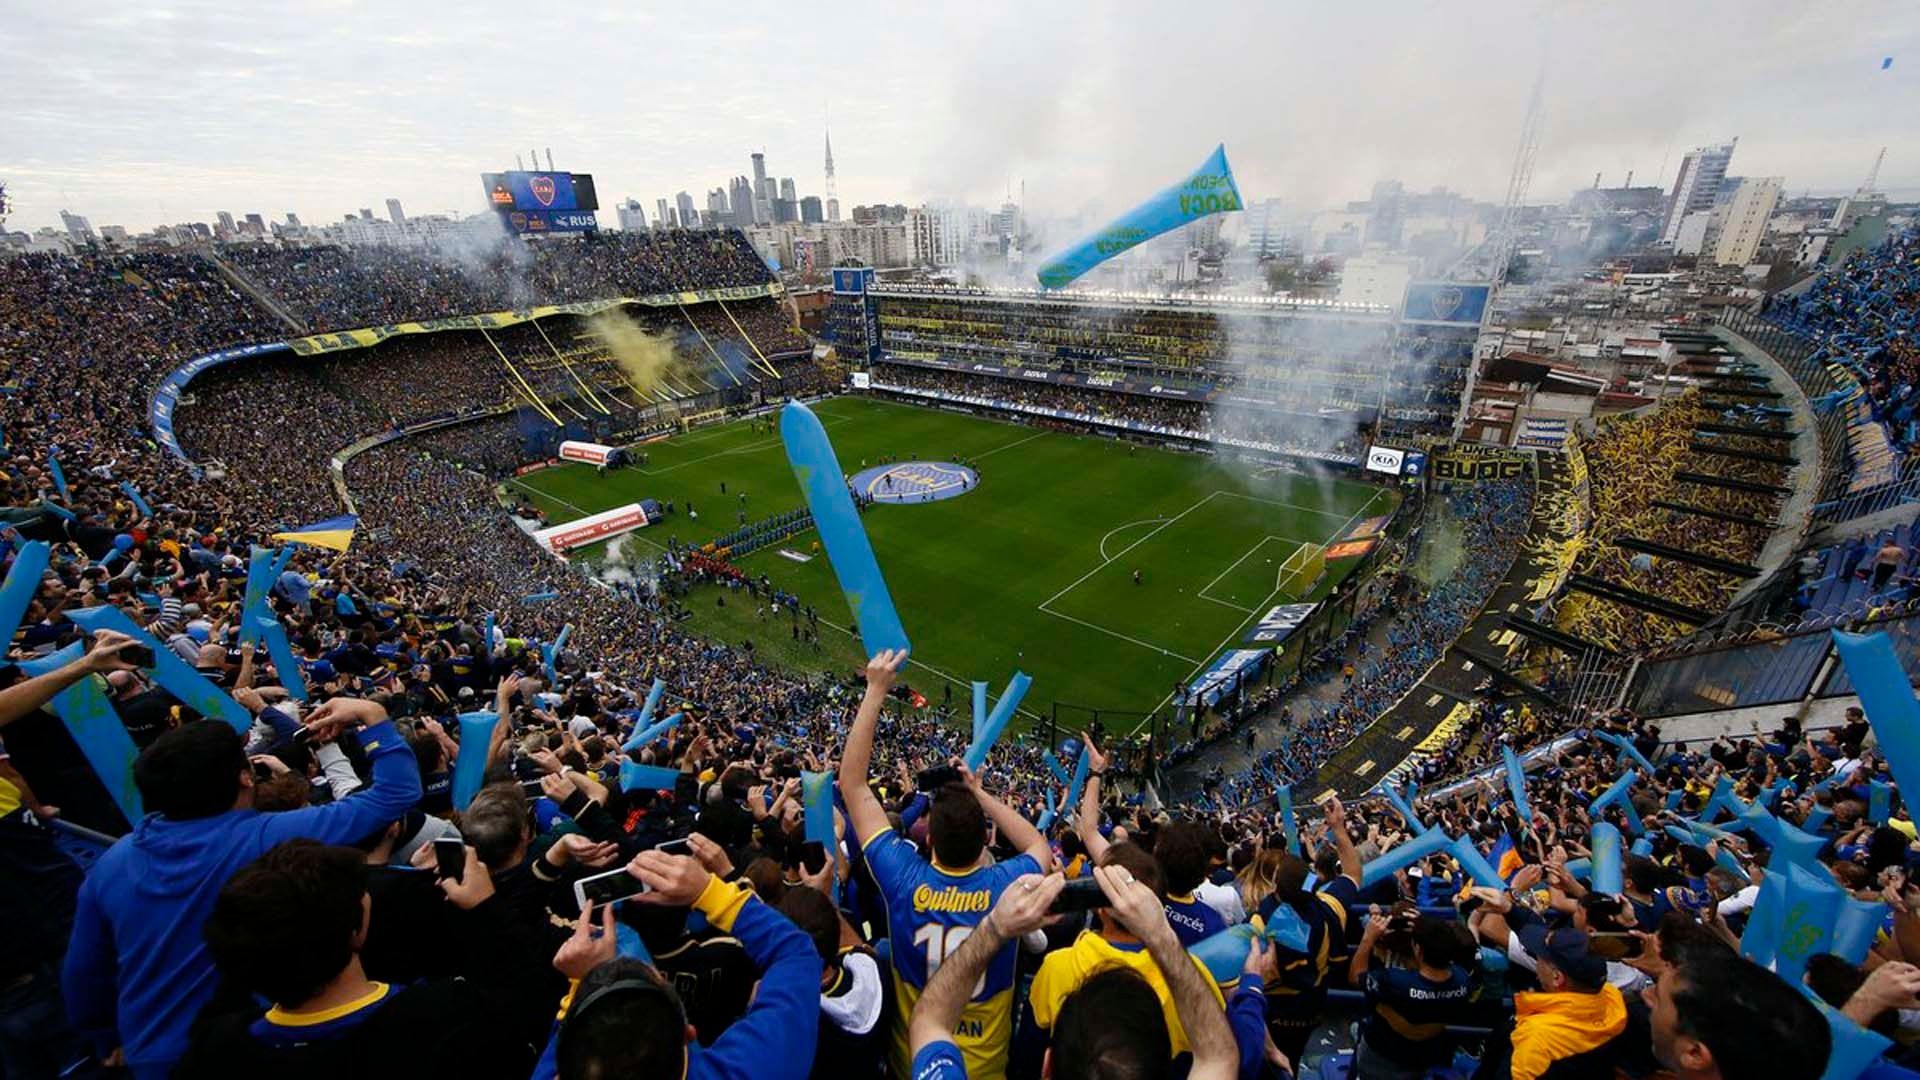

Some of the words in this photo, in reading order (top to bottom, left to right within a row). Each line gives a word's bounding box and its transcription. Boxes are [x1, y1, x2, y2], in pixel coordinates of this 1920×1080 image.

[1178, 191, 1238, 217] BOCA
[569, 215, 596, 228] RUS
[1375, 455, 1394, 465] KIA
[913, 883, 992, 912] Quilmes
[1164, 904, 1205, 933] Francés
